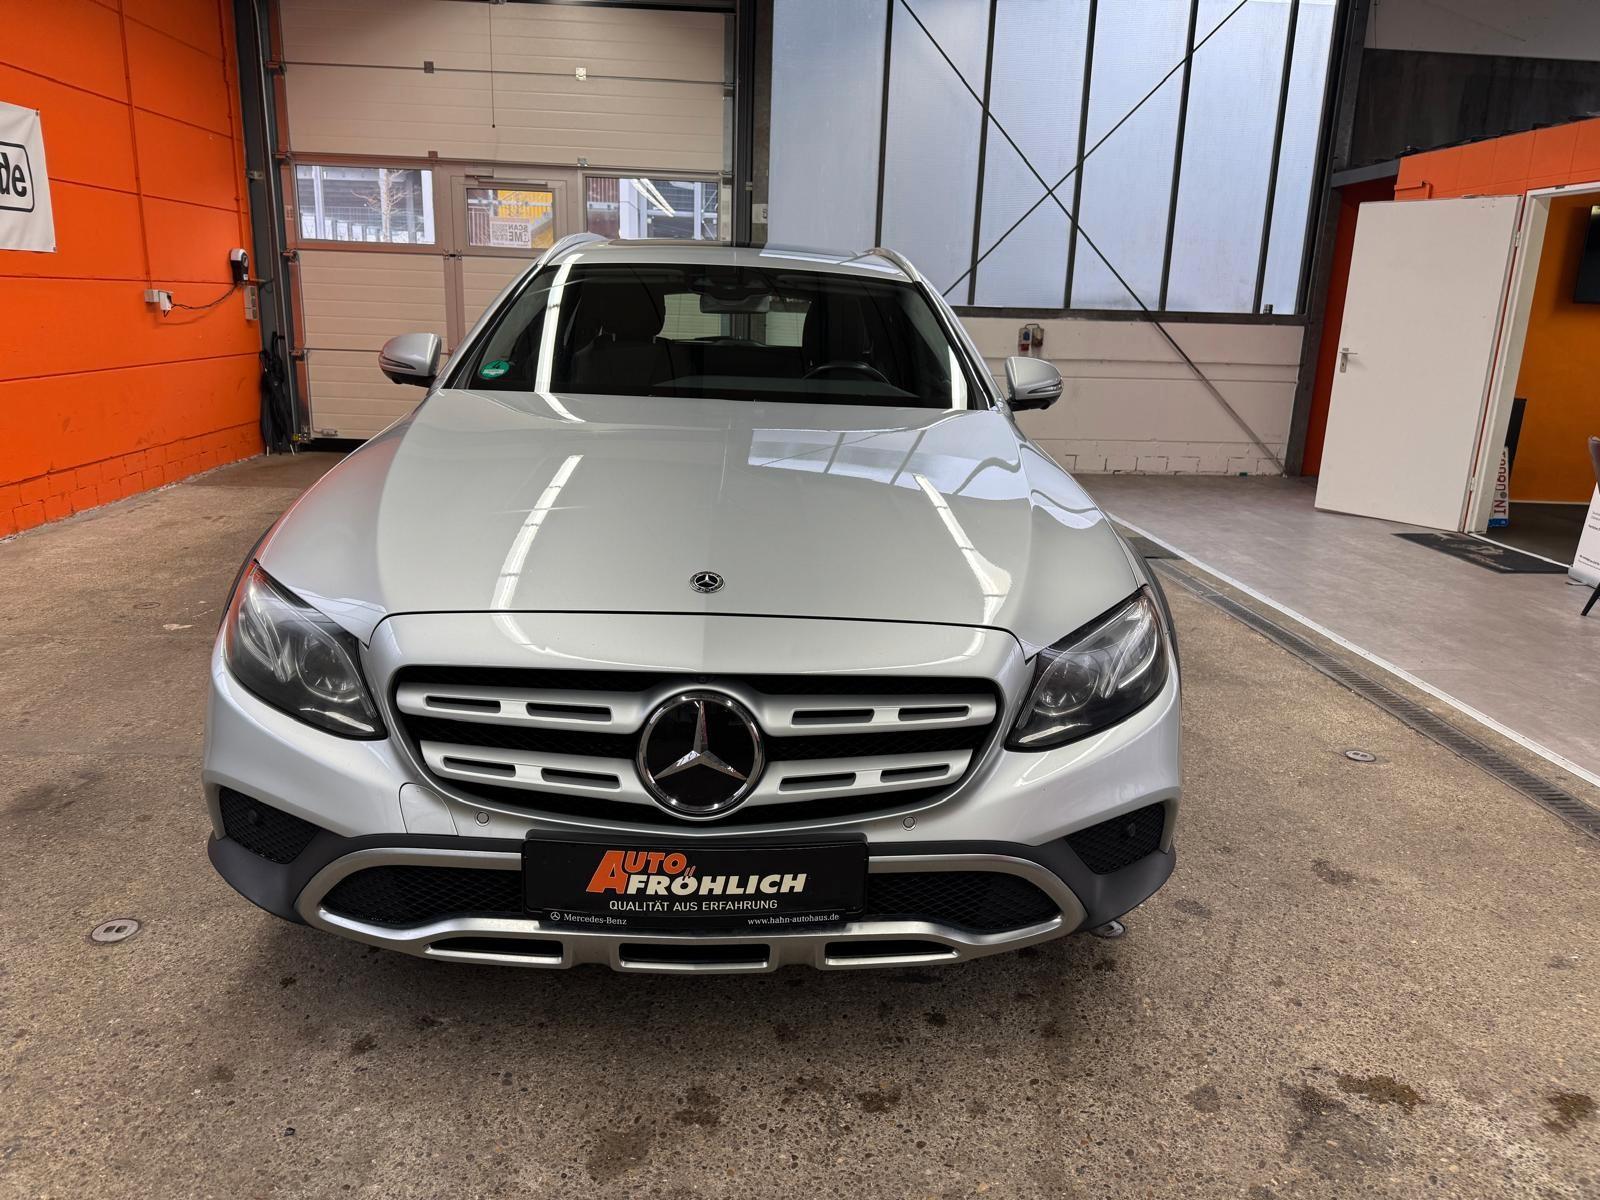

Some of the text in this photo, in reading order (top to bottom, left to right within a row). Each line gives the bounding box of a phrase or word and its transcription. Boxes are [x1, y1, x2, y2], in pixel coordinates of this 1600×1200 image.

[586, 850, 687, 894] AUTO
[626, 865, 807, 896] FRÖHLICH
[609, 900, 778, 911] QUALITÄT AUS ERFAHRUNG
[563, 913, 627, 925] Mercedes-Benz
[747, 913, 840, 925] www.hahn-autohaus.de
